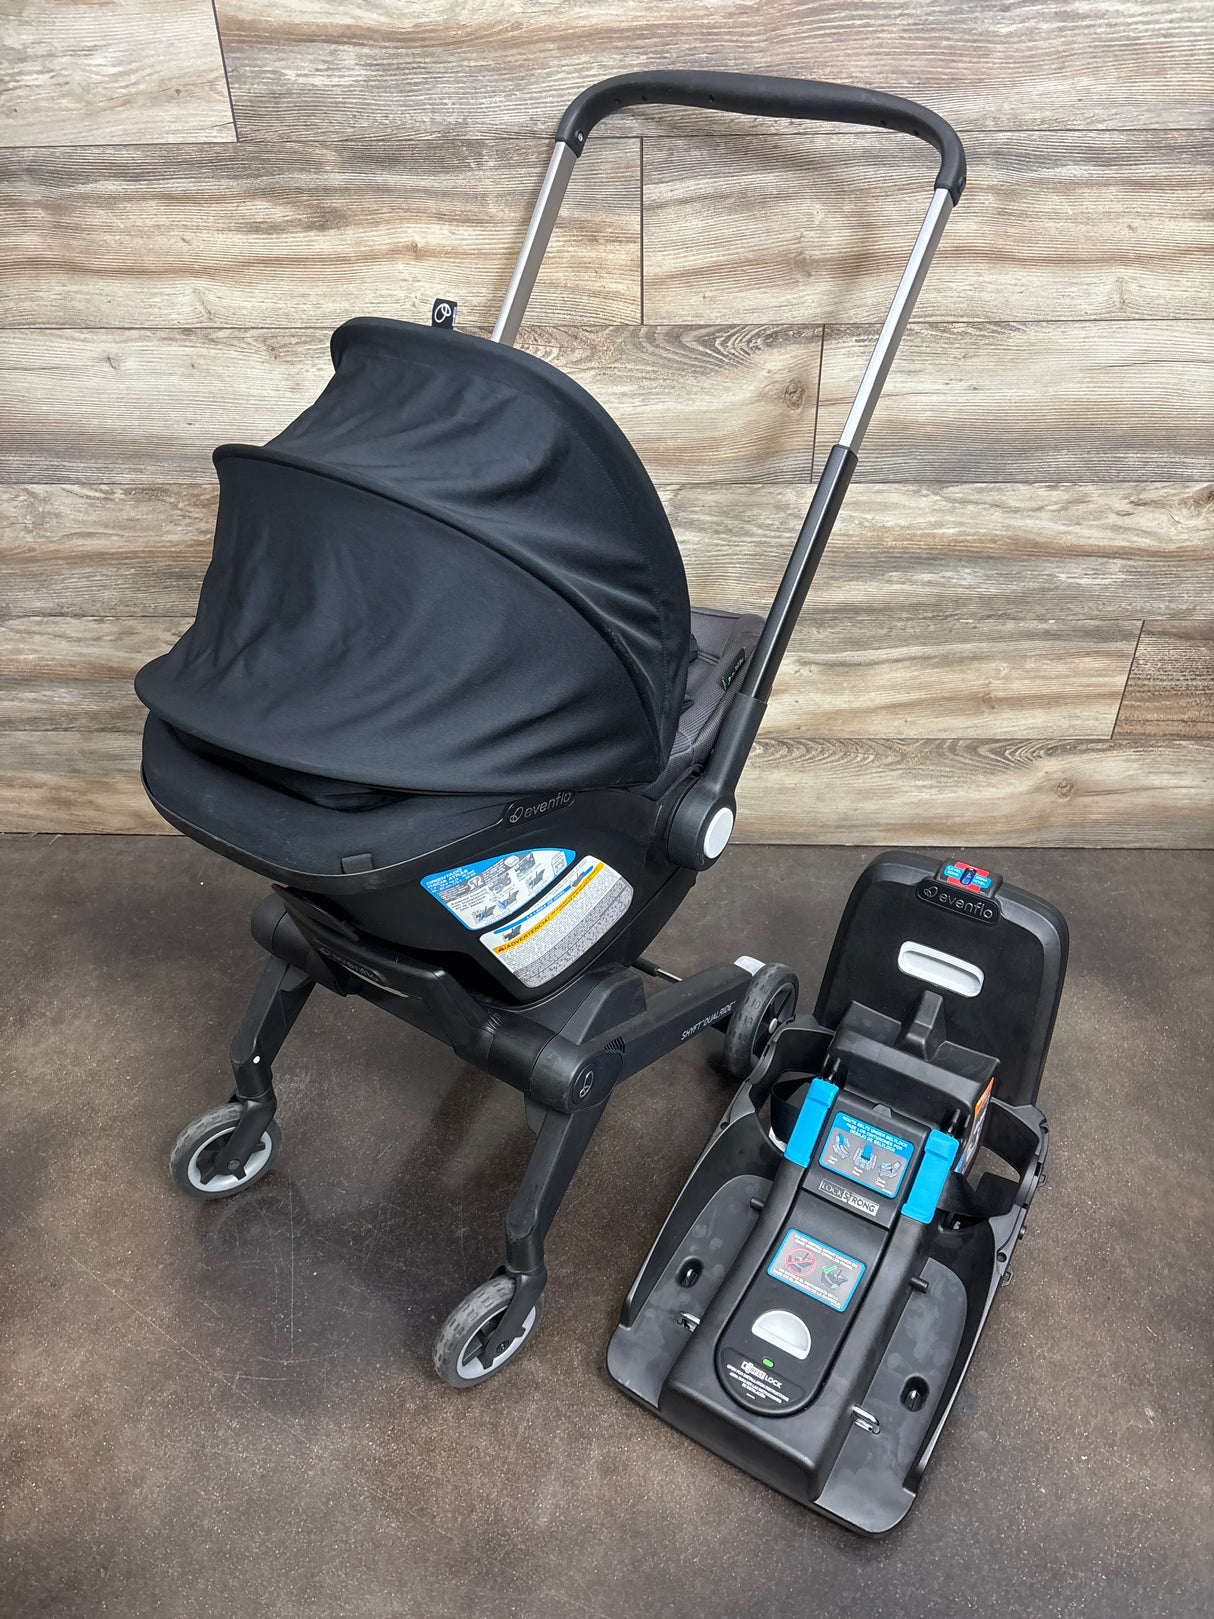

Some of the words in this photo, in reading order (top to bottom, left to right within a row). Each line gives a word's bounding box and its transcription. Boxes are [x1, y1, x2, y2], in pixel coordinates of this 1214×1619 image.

[524, 792, 572, 818] evenflo
[426, 868, 462, 886] ORIENTADO
[947, 866, 962, 874] LEVEL
[427, 880, 447, 888] HACIA
[938, 892, 993, 919] evenflo
[842, 1115, 856, 1124] ROUTE
[857, 1122, 870, 1130] BELTS
[870, 1128, 885, 1137] UNDER
[885, 1135, 907, 1148] BELTLOCK
[873, 1140, 895, 1152] BELTLOCK
[764, 1374, 782, 1388] LOCK
